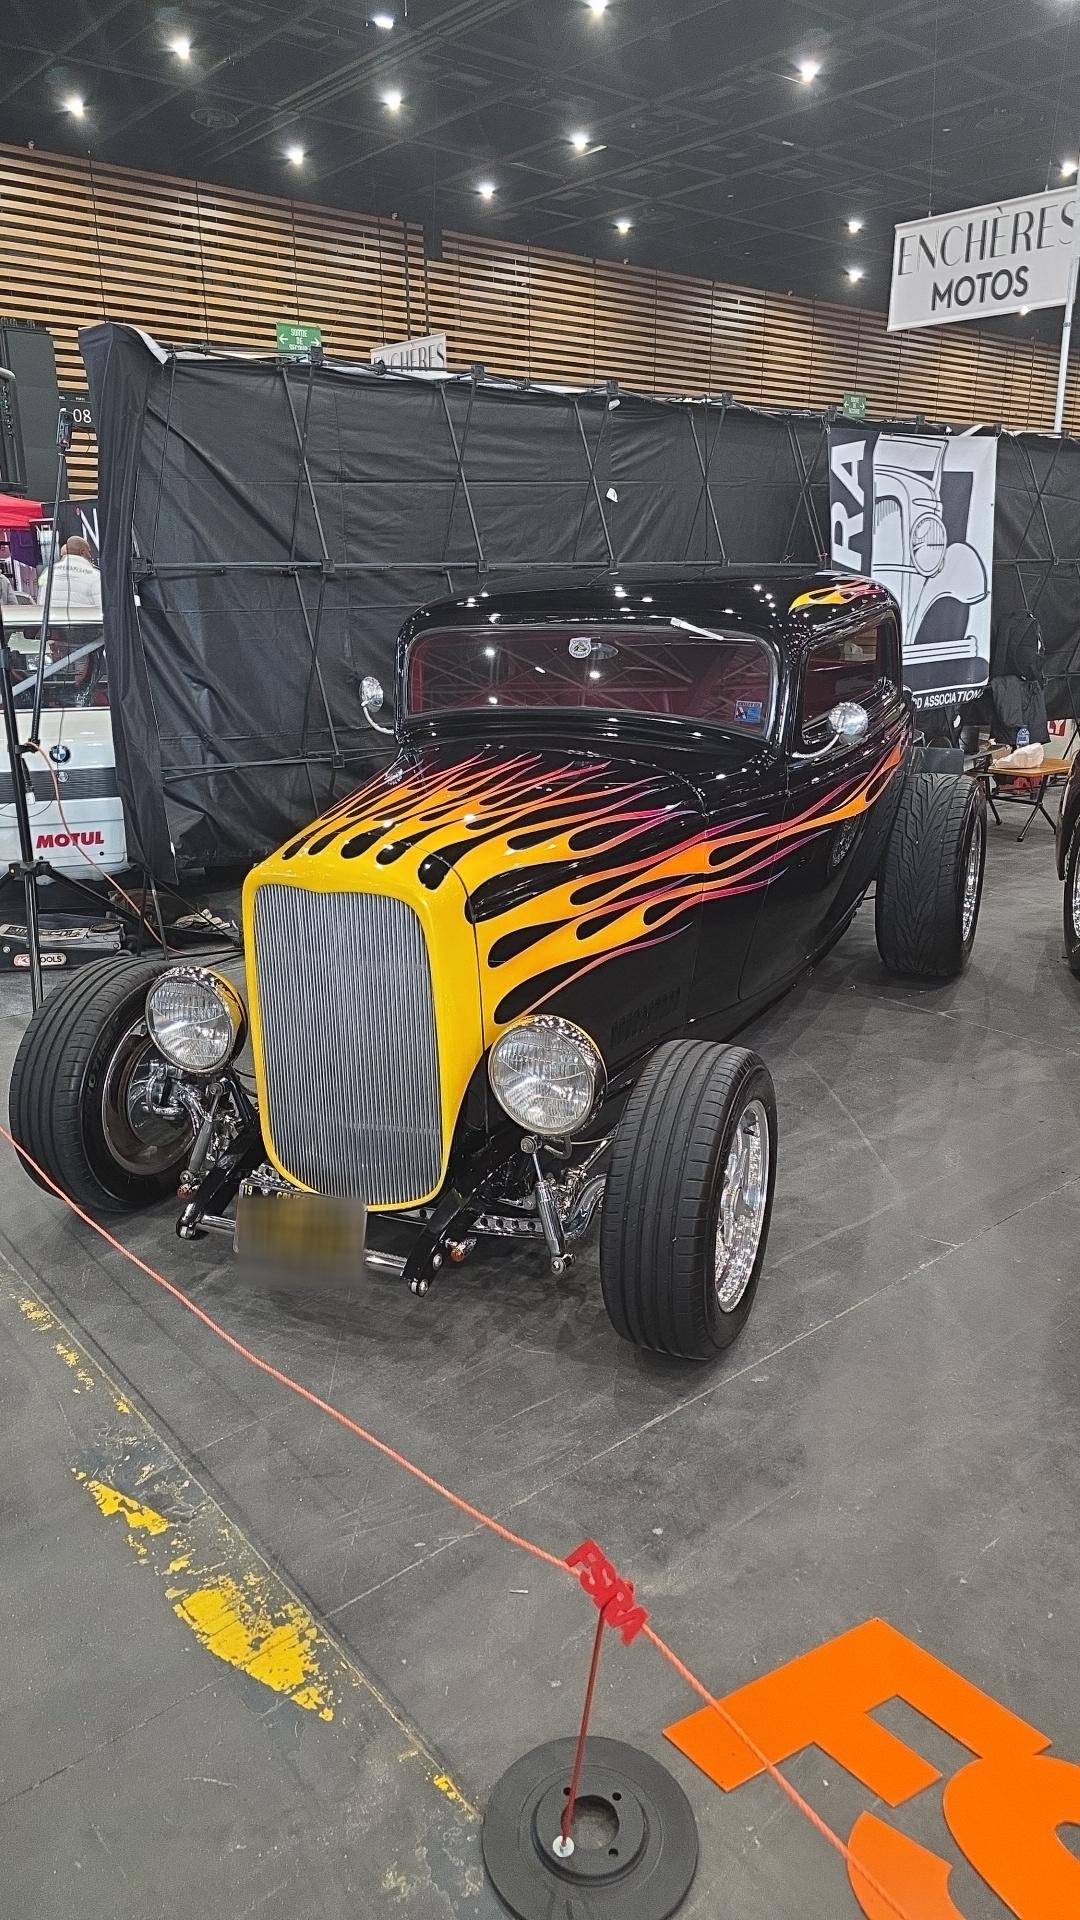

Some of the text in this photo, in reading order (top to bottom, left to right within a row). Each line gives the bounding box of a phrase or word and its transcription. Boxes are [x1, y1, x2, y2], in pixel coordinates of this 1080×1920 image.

[898, 200, 1077, 275] ENCHÈRES
[931, 265, 1030, 311] MOTOS
[73, 408, 92, 424] 08
[36, 831, 104, 849] MOTUL
